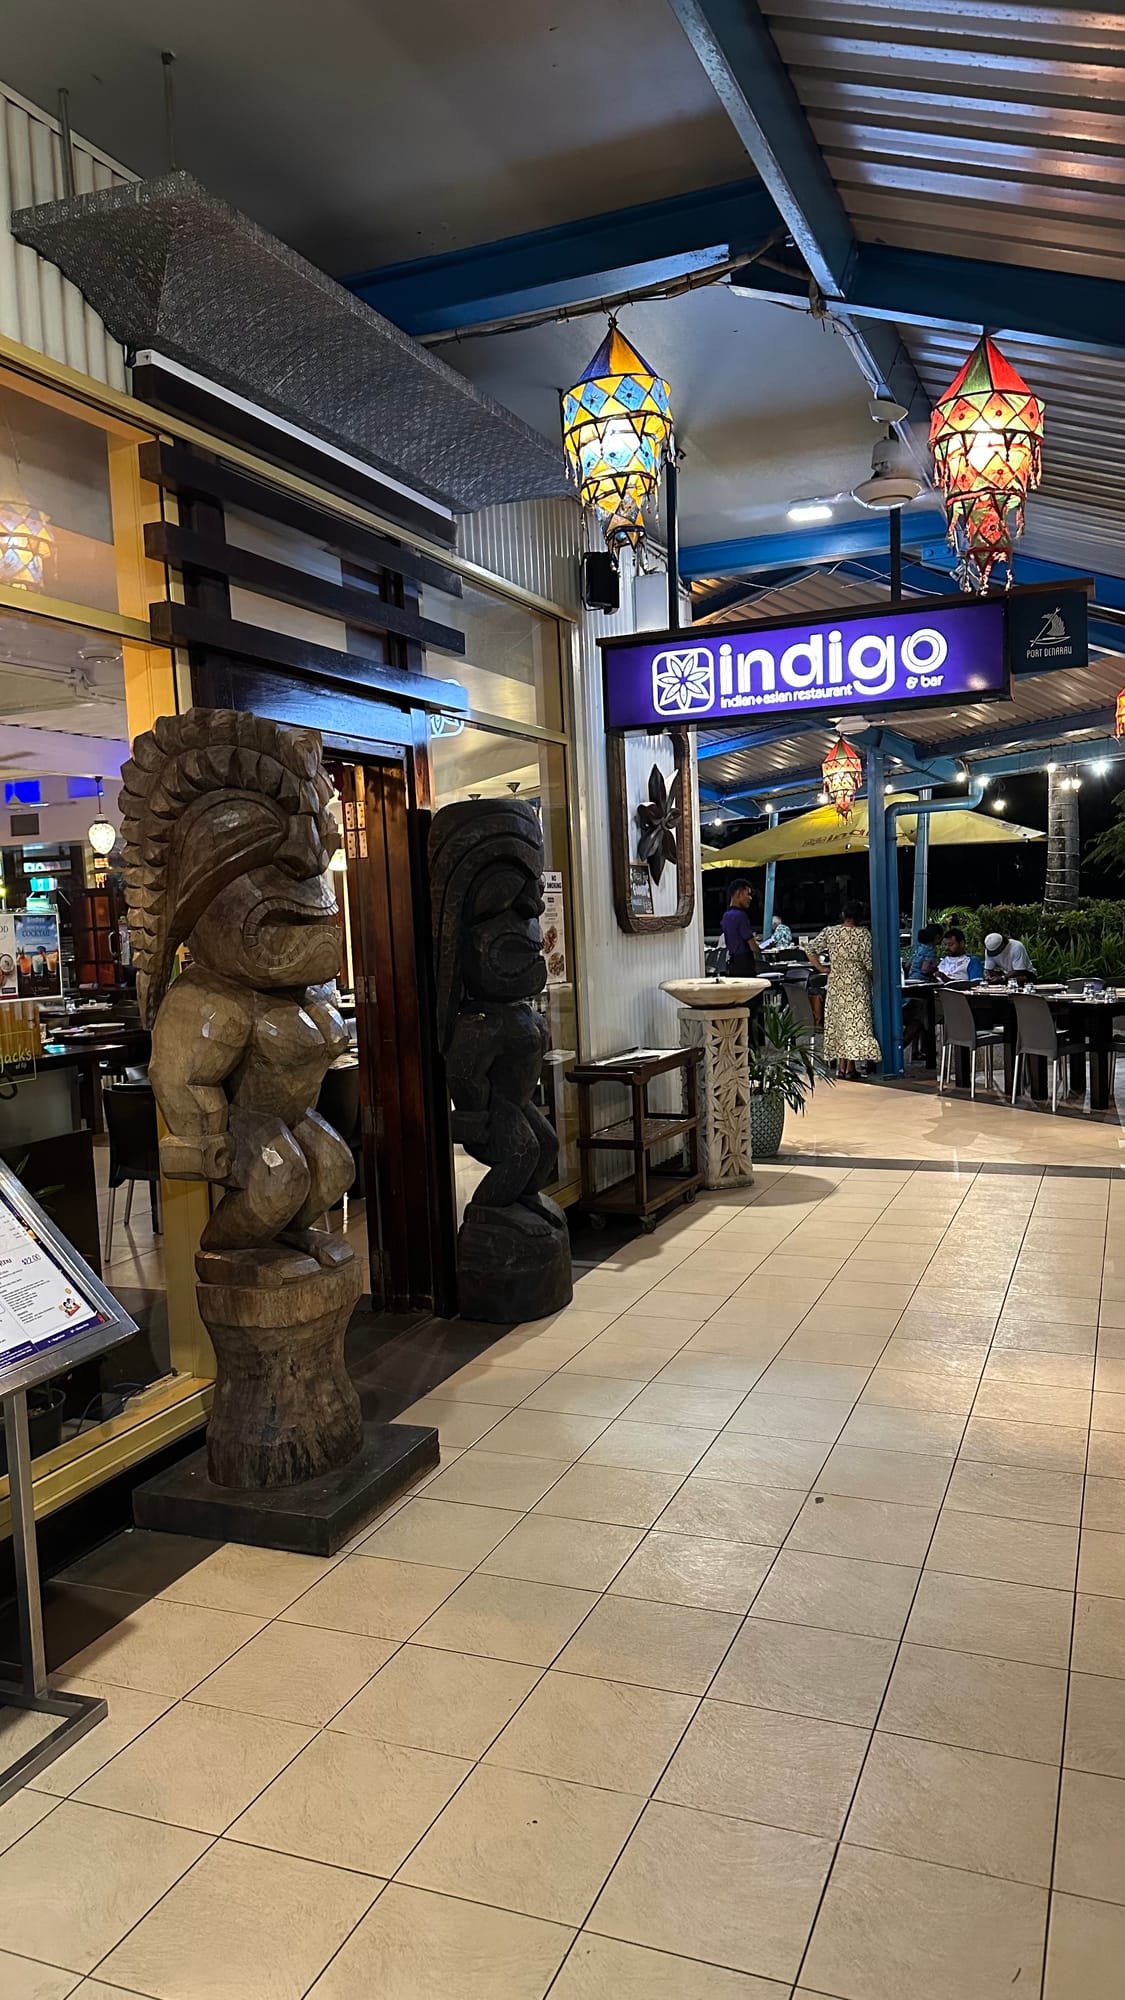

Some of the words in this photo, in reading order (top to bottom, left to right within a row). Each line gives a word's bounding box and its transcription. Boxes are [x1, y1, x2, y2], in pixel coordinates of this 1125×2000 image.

[1026, 648, 1043, 659] PORT
[1044, 645, 1073, 657] DENARAU
[719, 628, 948, 696] indigo
[920, 674, 944, 688] bar
[794, 684, 853, 701] restaurant
